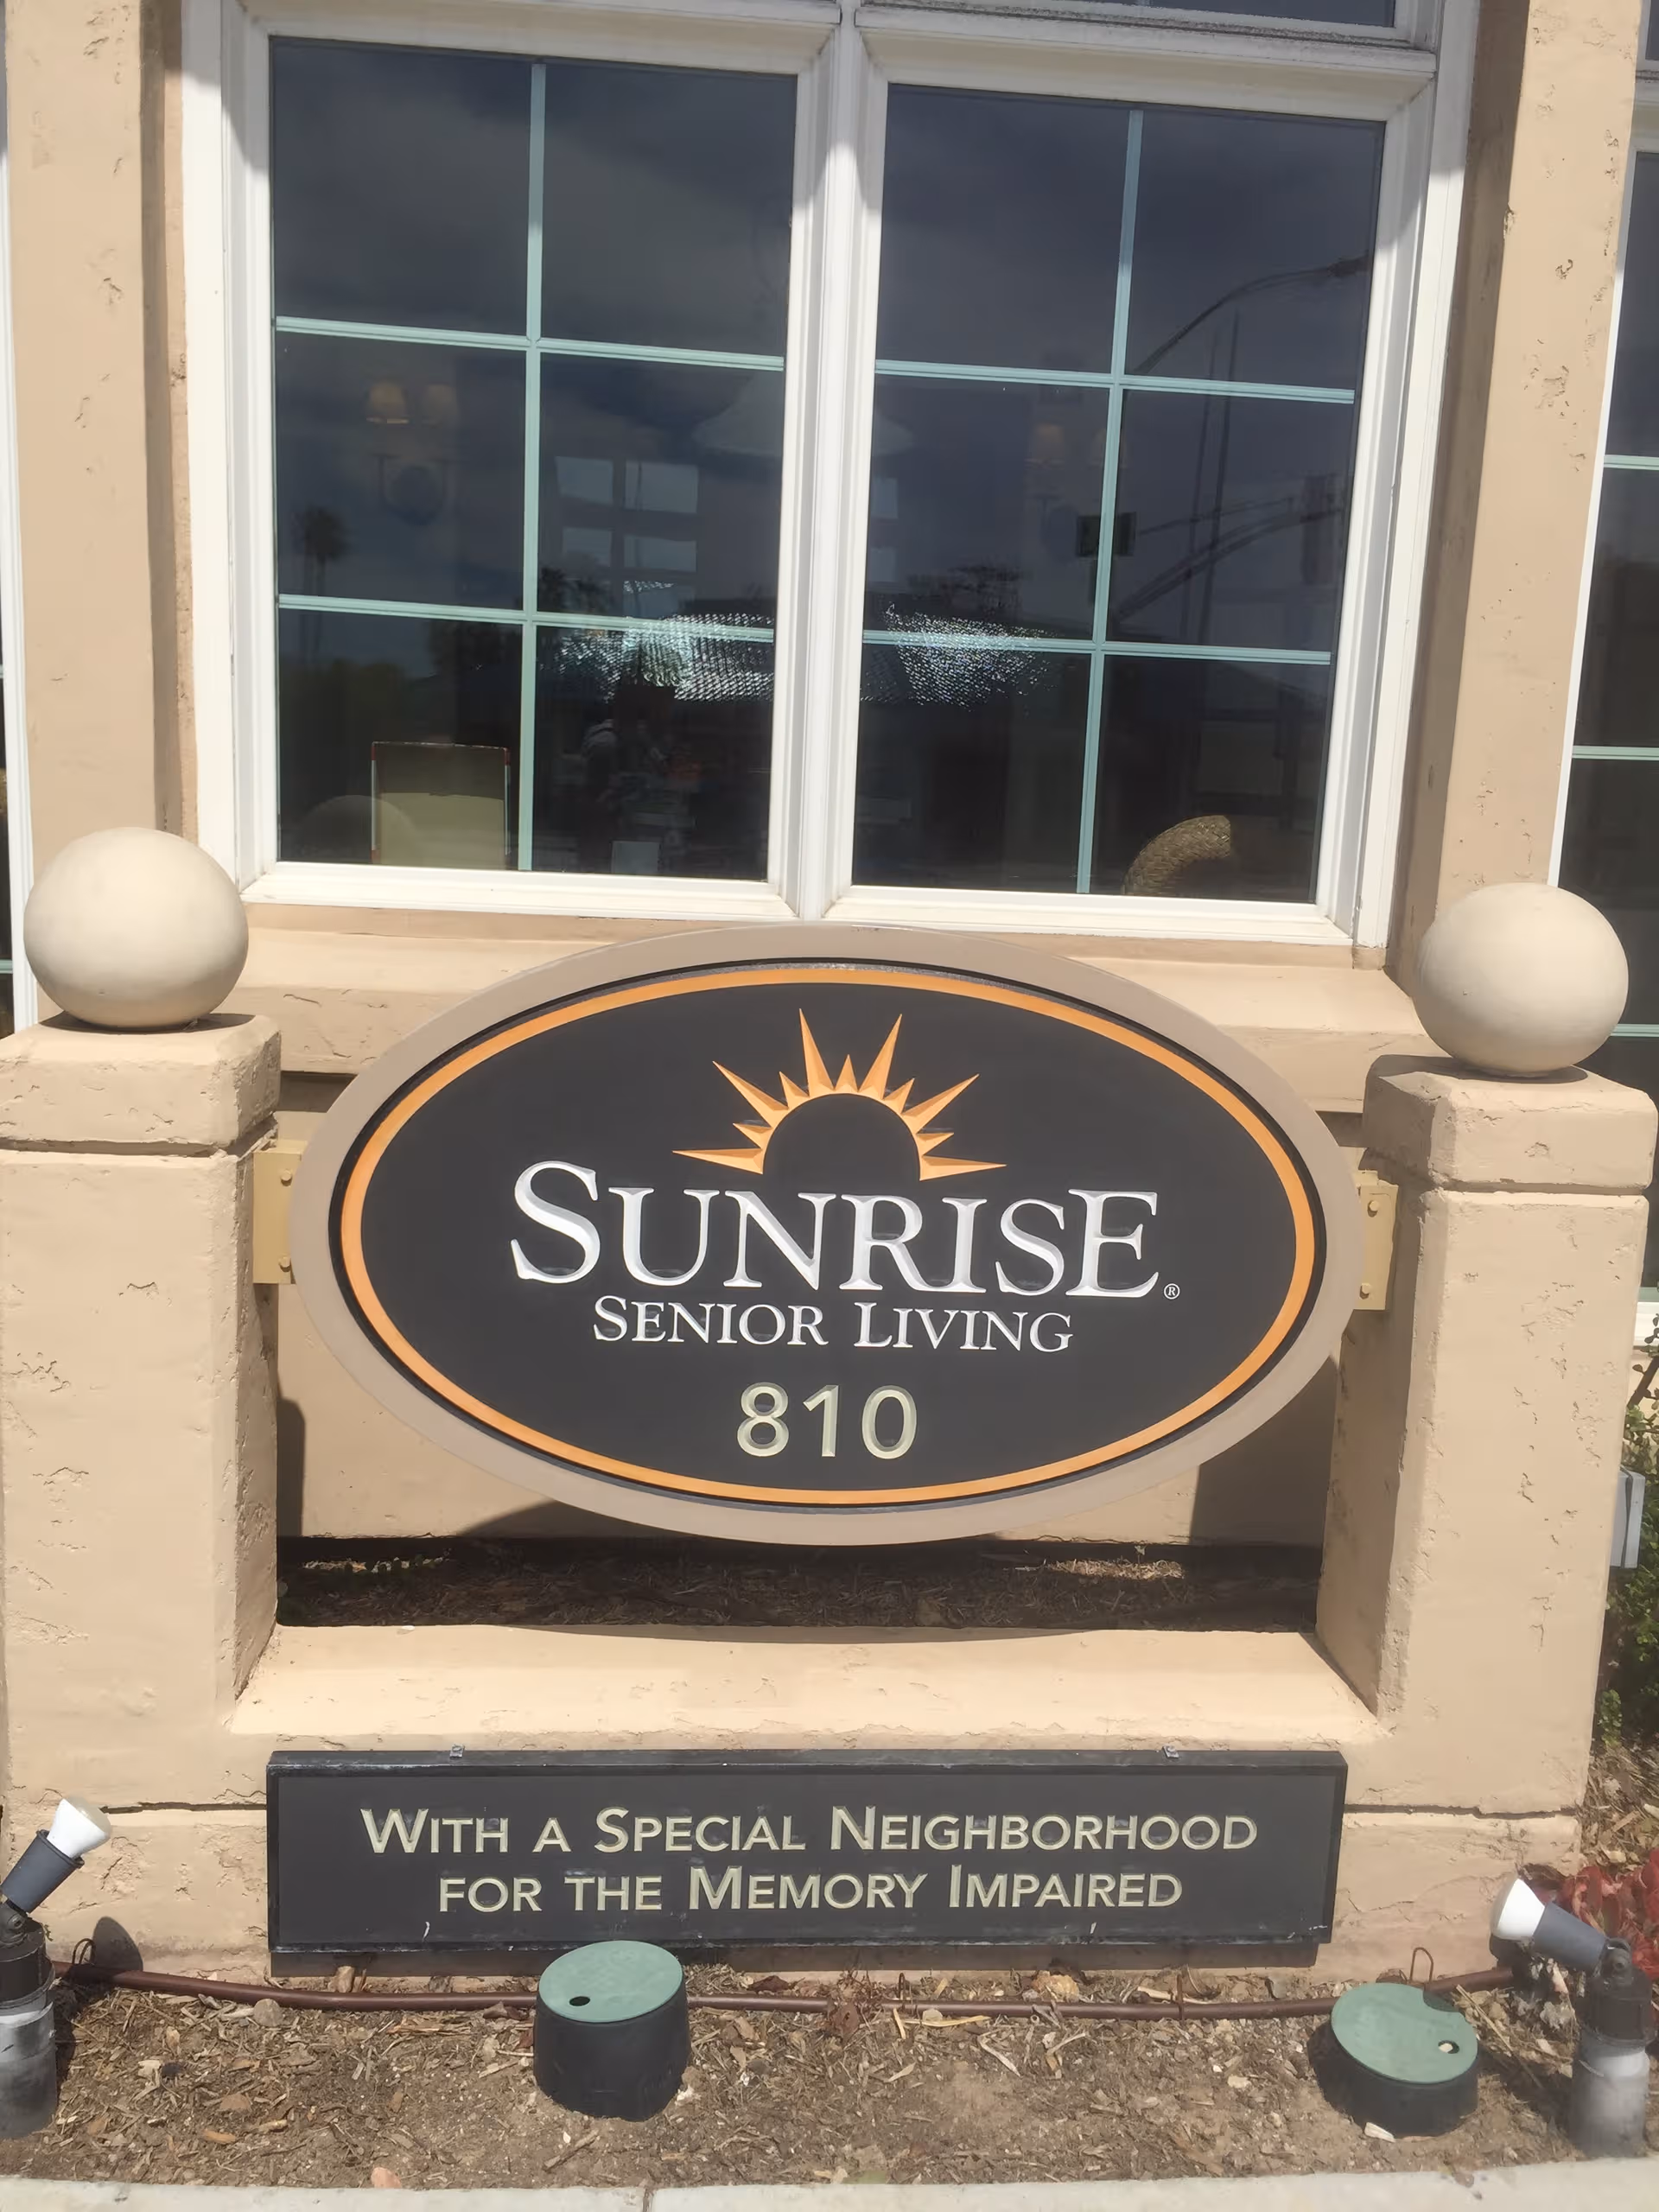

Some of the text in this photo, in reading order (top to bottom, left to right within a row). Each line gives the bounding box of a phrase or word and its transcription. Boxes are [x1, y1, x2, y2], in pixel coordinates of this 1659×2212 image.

[510, 1160, 1160, 1300] SUNRISE
[593, 1294, 1074, 1354] SENIOR LIVING
[736, 1382, 918, 1460] 810
[359, 1806, 1258, 1854] WITH A SPECIAL NEIGHBORHOOD
[438, 1864, 1184, 1913] FOR THE MEMORY IMPAIRED
